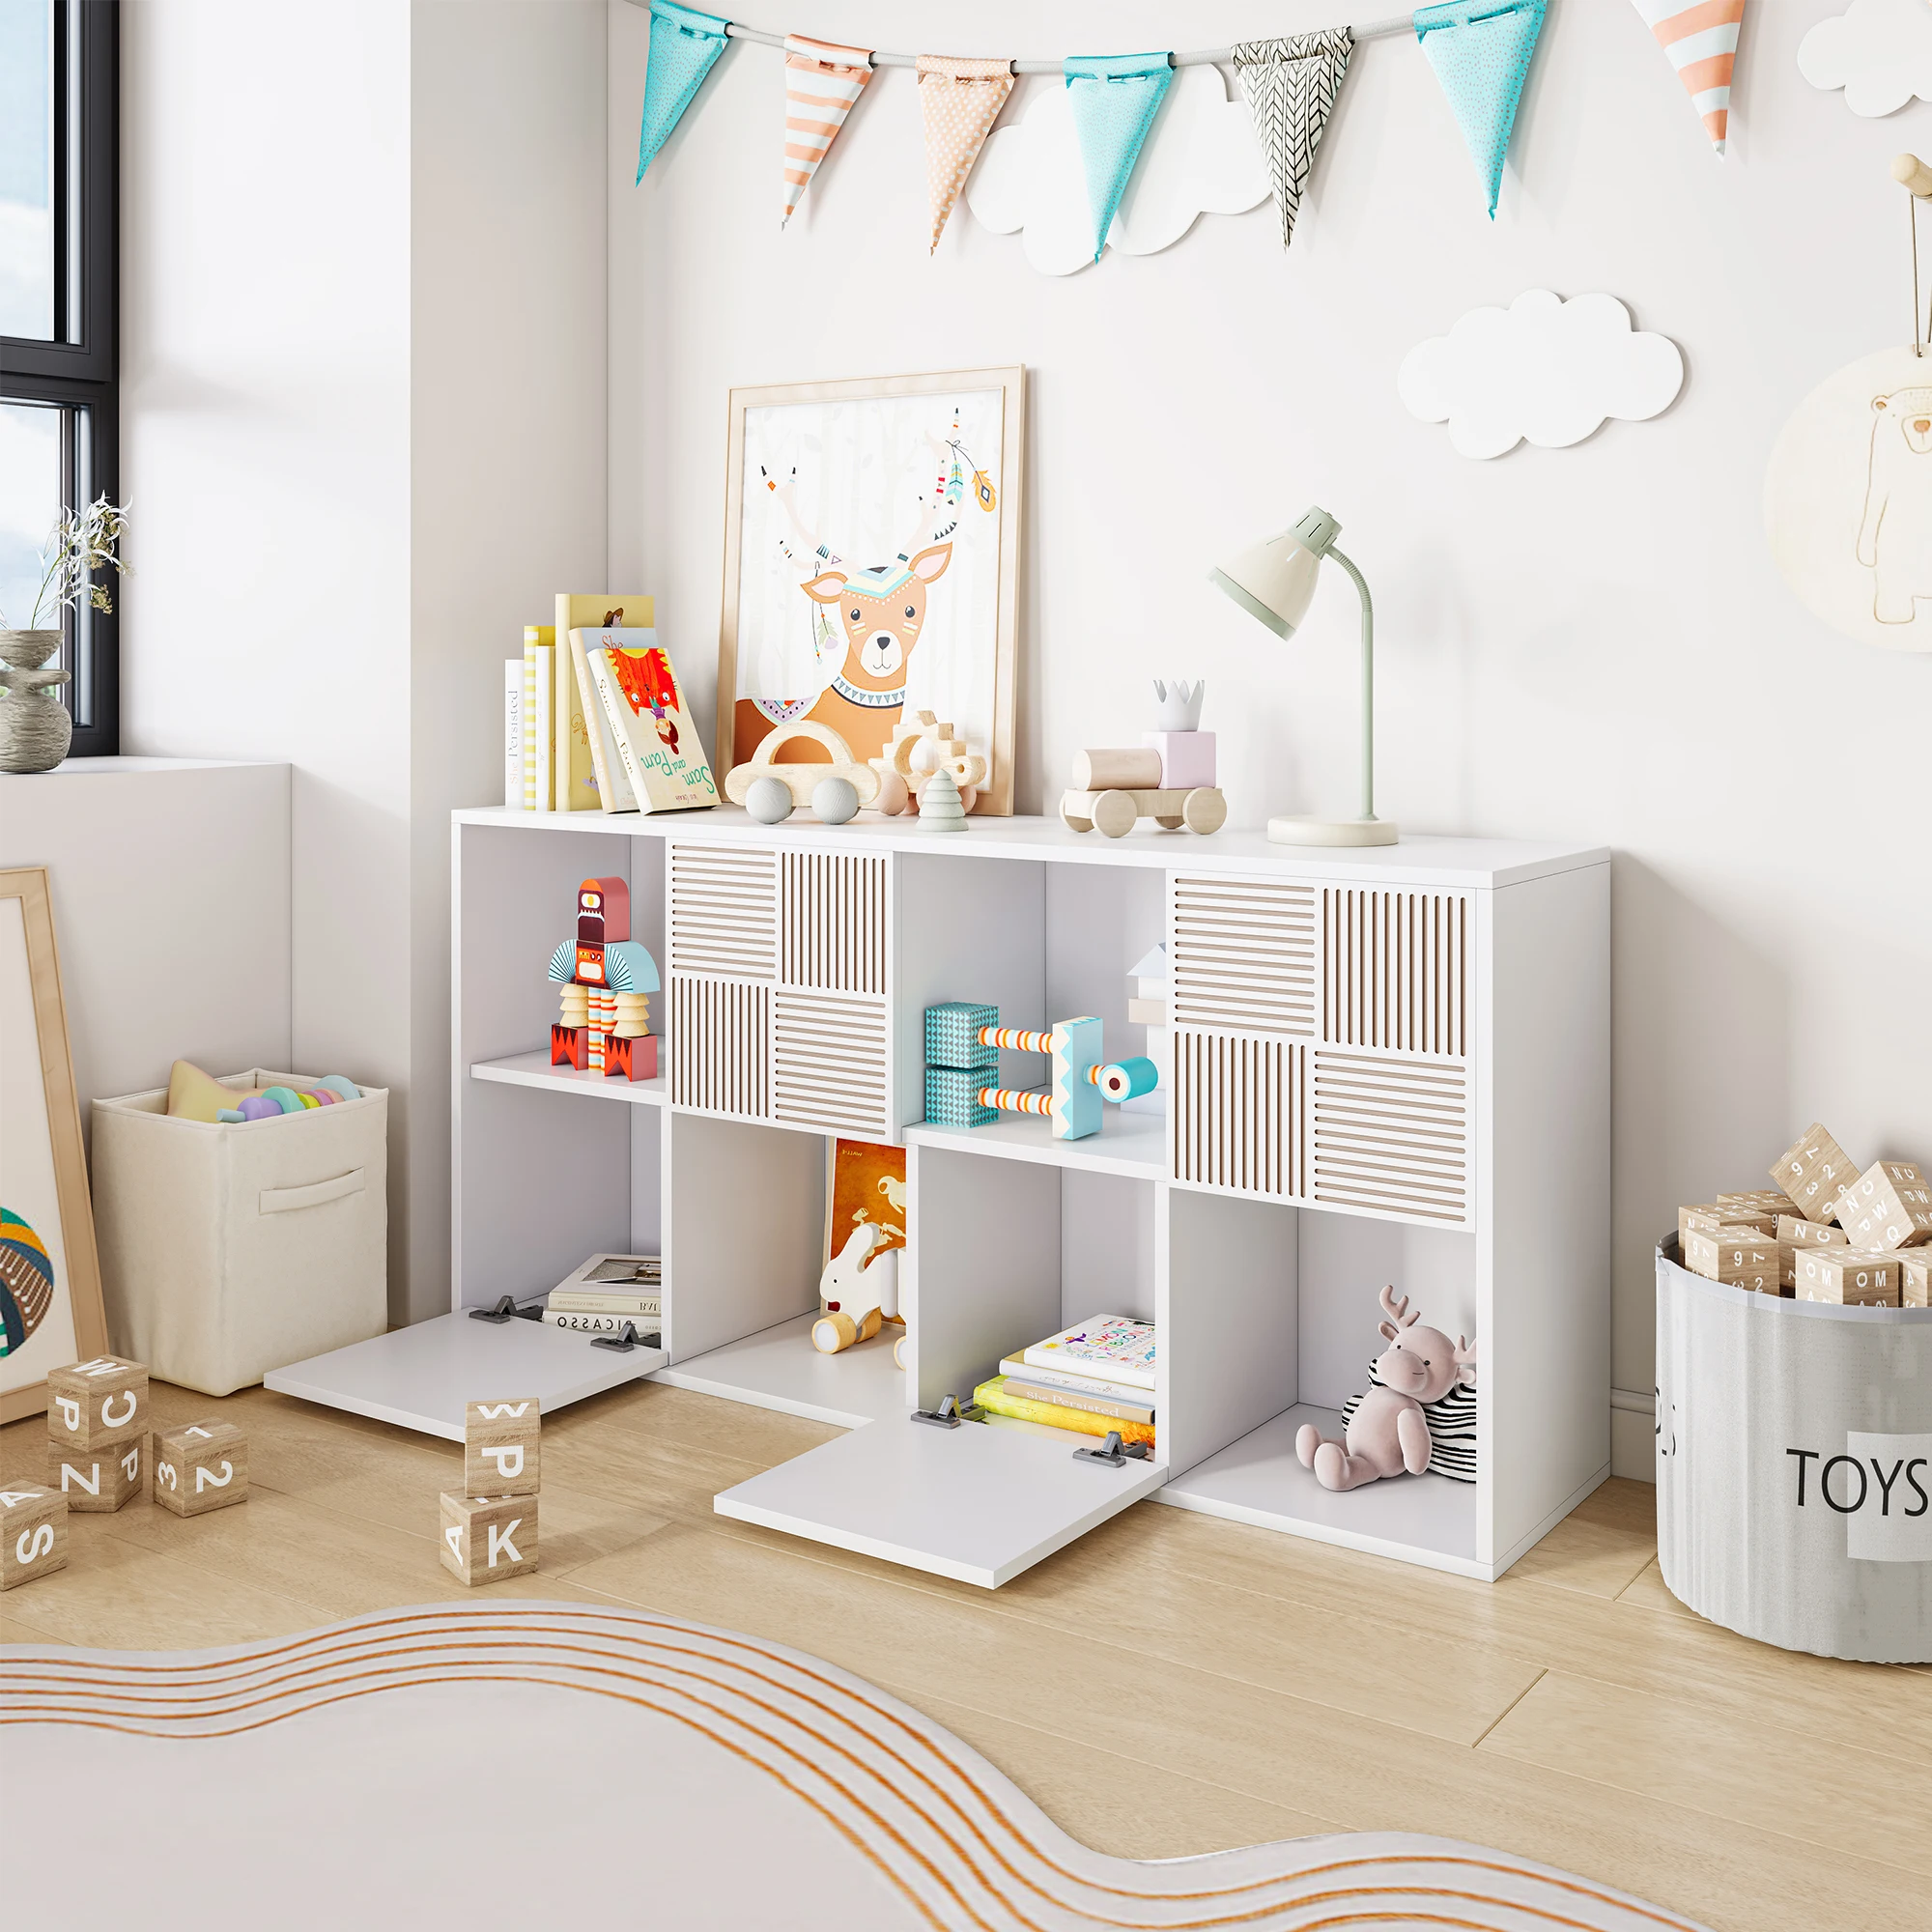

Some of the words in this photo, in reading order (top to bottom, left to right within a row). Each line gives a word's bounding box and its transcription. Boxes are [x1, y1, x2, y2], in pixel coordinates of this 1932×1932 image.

[508, 690, 518, 757] Persisted
[640, 751, 673, 777] Pam
[671, 759, 686, 773] and
[682, 765, 715, 794] Sam
[1822, 1164, 1835, 1180] 2
[1795, 1224, 1806, 1238] N
[1734, 1250, 1743, 1267] 9
[1754, 1277, 1764, 1293] 2
[1822, 1267, 1832, 1287] M
[1876, 1270, 1886, 1287] M
[71, 1358, 129, 1377] W
[56, 1396, 79, 1432] P
[101, 1391, 137, 1428] C
[477, 1403, 529, 1419] W
[1026, 1391, 1048, 1403] She
[1052, 1395, 1120, 1417] Persisted
[122, 1447, 137, 1482] P
[481, 1445, 524, 1478] P
[158, 1461, 177, 1492] 3
[196, 1461, 233, 1493] 2
[1786, 1448, 1929, 1517] TOYS
[0, 1492, 44, 1508] A
[15, 1524, 54, 1565] S
[445, 1526, 464, 1567] A
[489, 1519, 524, 1569] K
